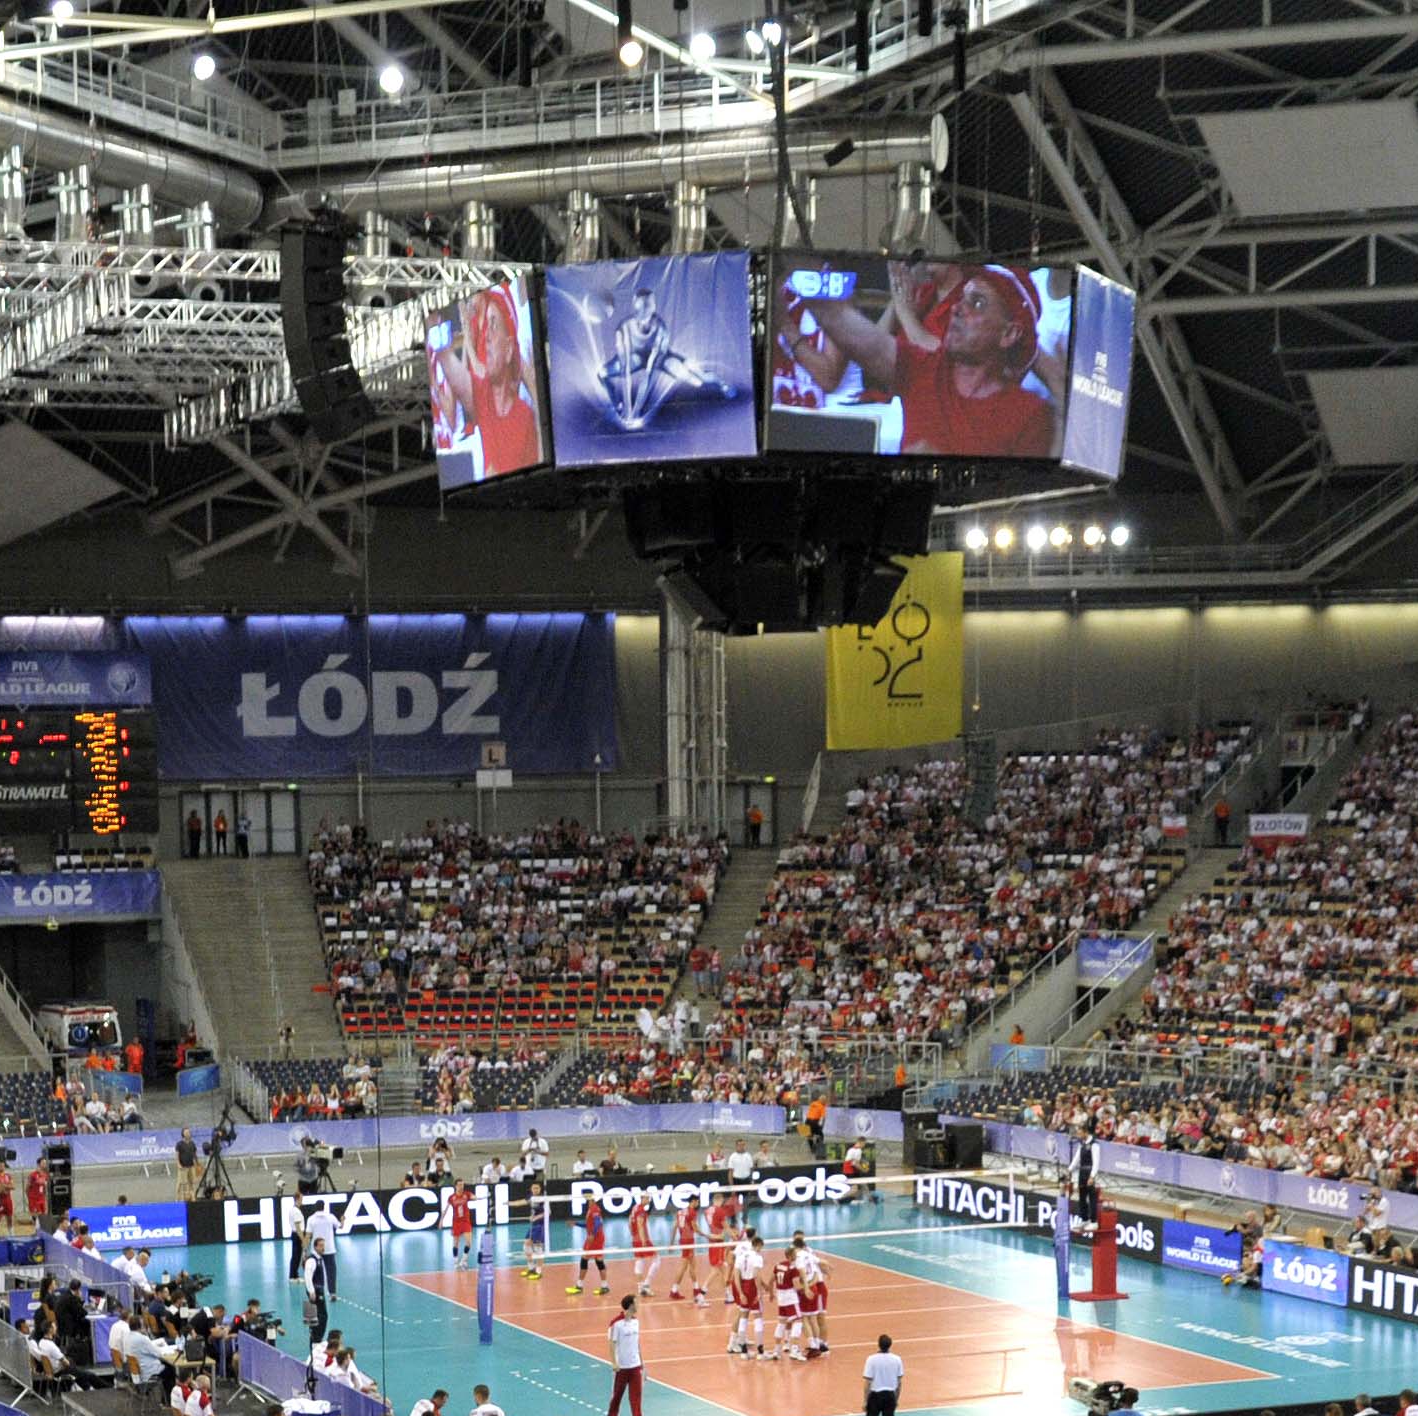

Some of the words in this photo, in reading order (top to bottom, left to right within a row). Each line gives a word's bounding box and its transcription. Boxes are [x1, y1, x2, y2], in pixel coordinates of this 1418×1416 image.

[12, 660, 38, 673] FIVB
[24, 682, 91, 695] LEAGUE
[236, 652, 501, 737] ŁÓDŹ
[13, 880, 93, 907] ŁÓDŹ
[419, 1117, 475, 1138] ŁÓDŹ
[148, 1146, 177, 1155] LEAGU
[571, 1177, 720, 1216] Power
[737, 1167, 851, 1203] ools
[1307, 1183, 1350, 1210] ŁÓDŹ
[112, 1215, 137, 1225] FIVB
[916, 1175, 1025, 1226] HITACHI
[1114, 1221, 1155, 1252] ools
[91, 1229, 123, 1243] RLD
[124, 1226, 184, 1241] LEAGUE
[1165, 1246, 1200, 1263] WORLD
[1200, 1253, 1241, 1271] LEAGUE
[1272, 1255, 1338, 1292] ŁÓDŹ
